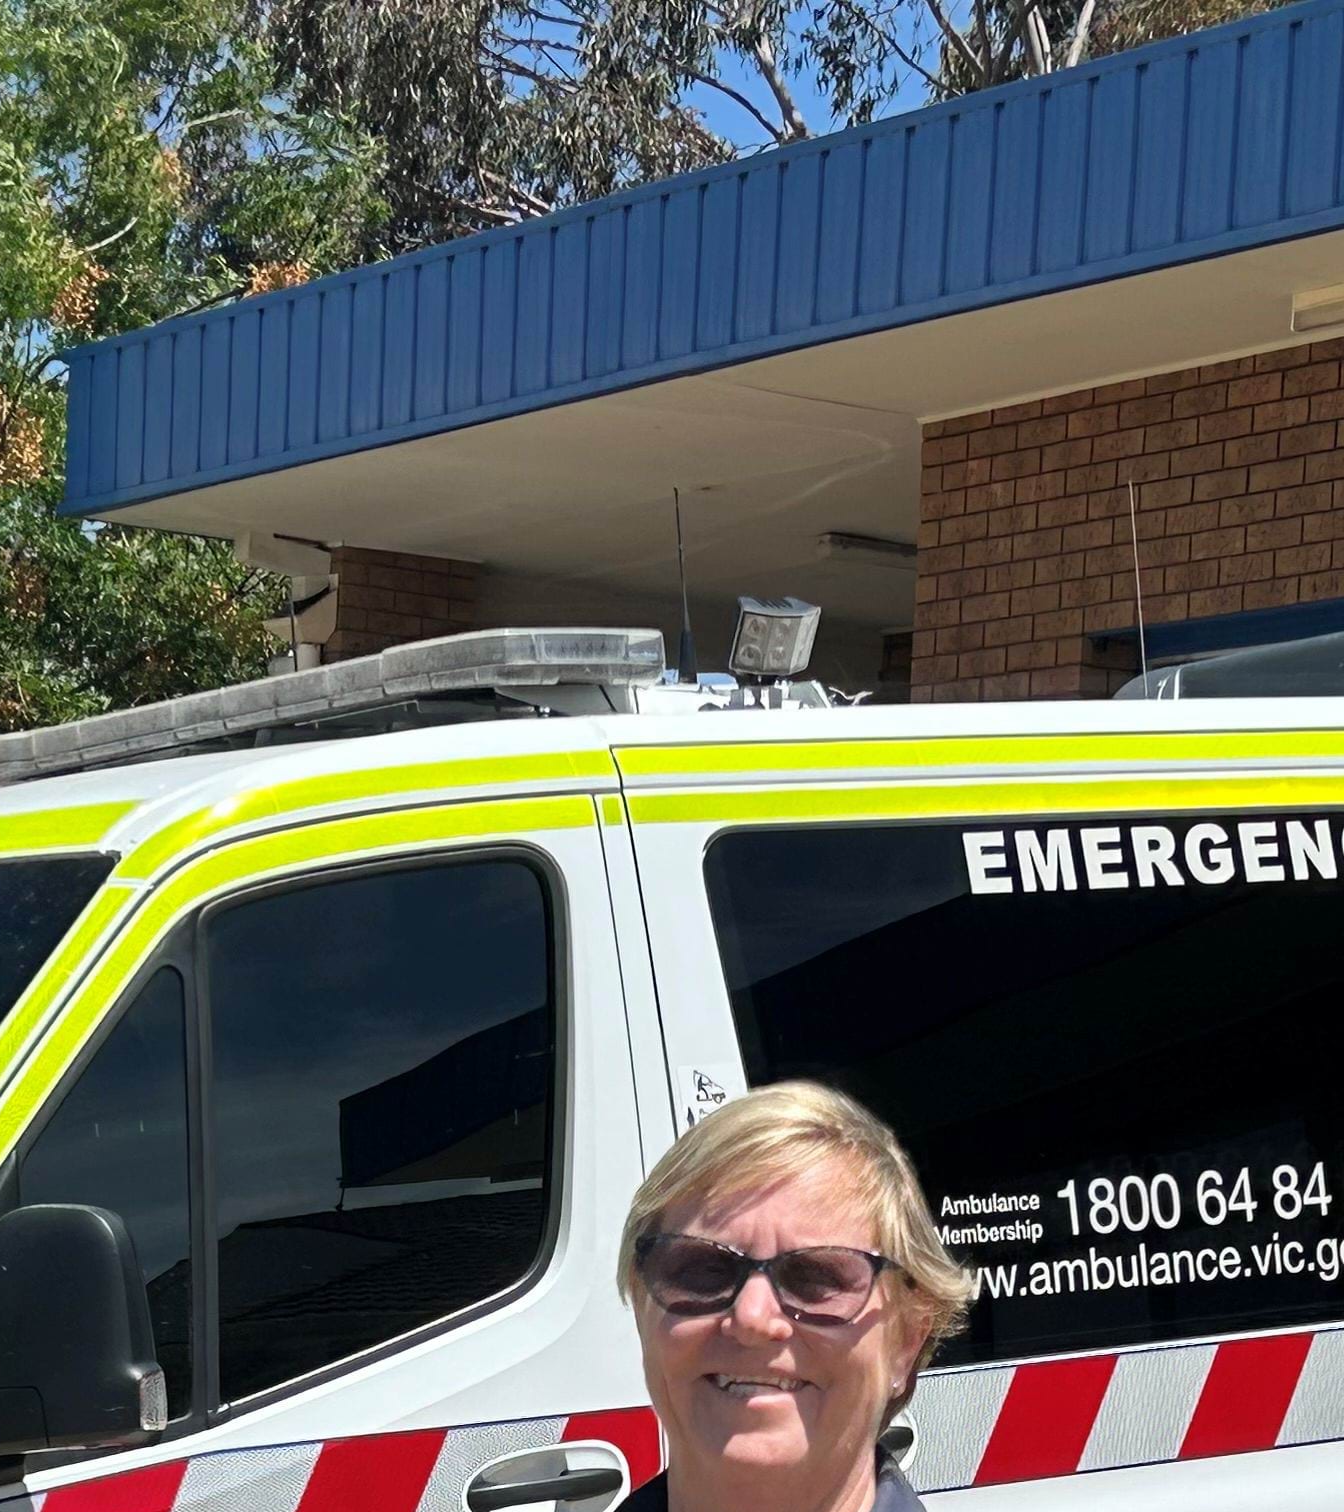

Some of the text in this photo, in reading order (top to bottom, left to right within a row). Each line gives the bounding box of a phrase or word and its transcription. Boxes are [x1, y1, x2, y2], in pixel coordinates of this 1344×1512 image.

[940, 1192, 1041, 1217] Ambulance
[1056, 1172, 1182, 1236] 1800
[1196, 1166, 1258, 1226] 64
[1271, 1161, 1333, 1220] 84
